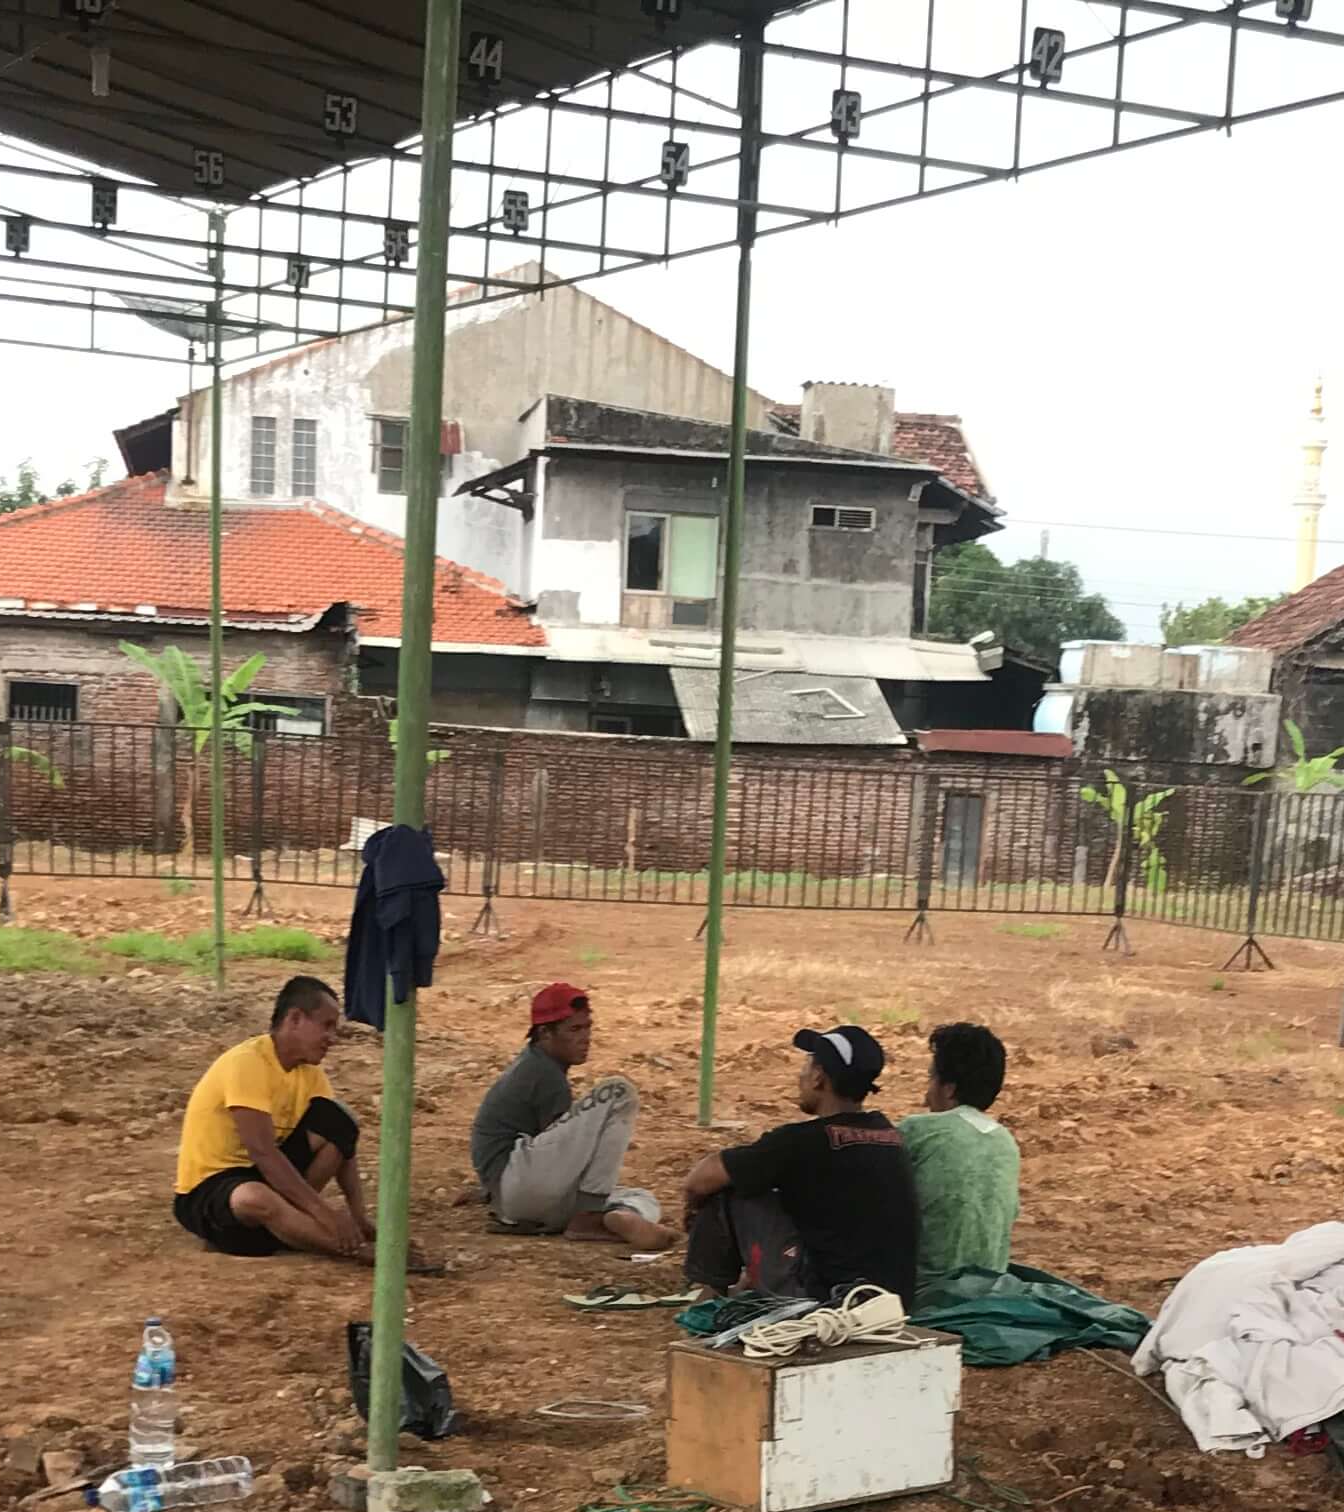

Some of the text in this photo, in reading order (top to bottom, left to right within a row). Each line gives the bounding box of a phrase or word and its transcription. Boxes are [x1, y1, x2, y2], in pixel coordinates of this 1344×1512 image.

[470, 37, 504, 80] 44
[1033, 33, 1064, 77] 42
[325, 93, 357, 134] 53
[831, 95, 860, 133] 43
[194, 151, 224, 185] 56
[661, 145, 689, 183] 54
[504, 194, 529, 226] 55
